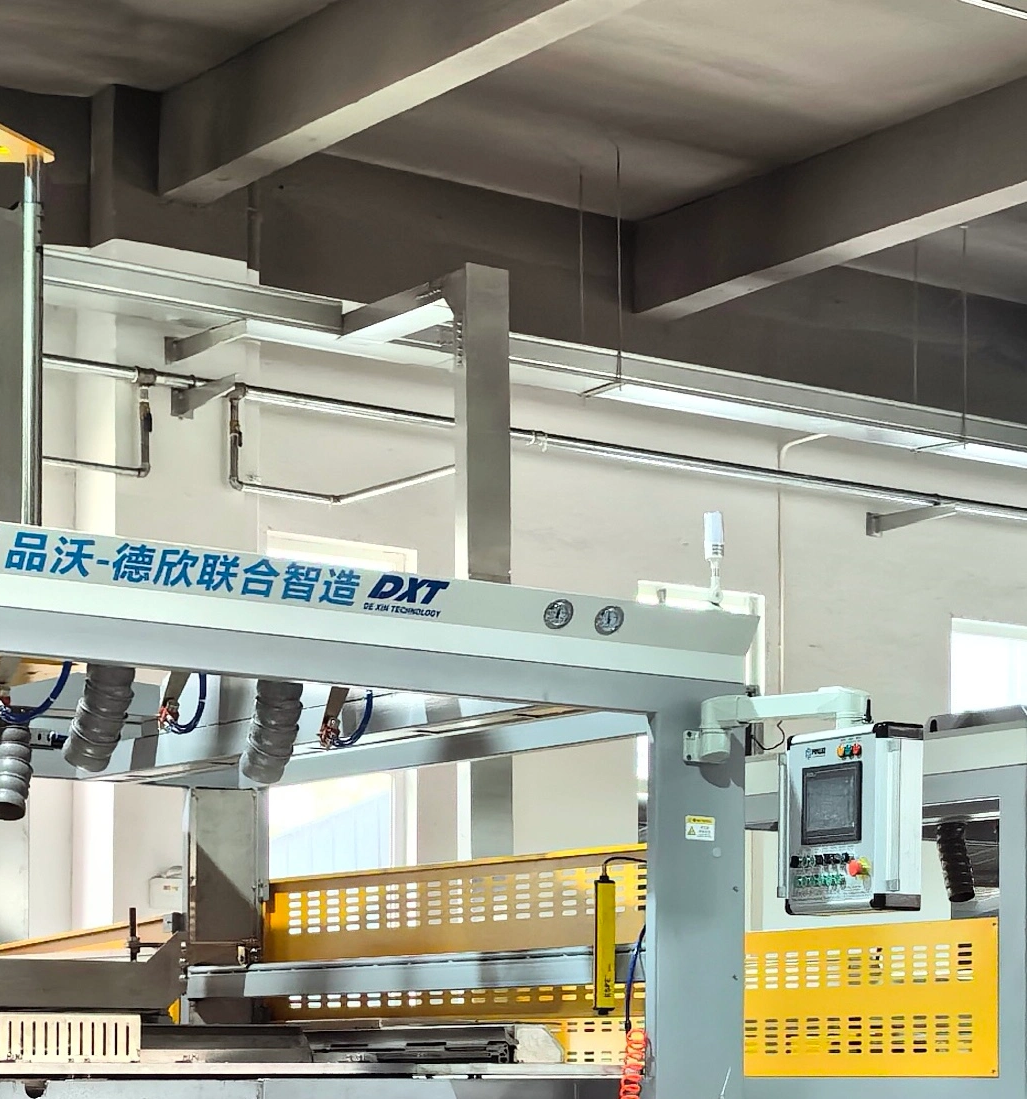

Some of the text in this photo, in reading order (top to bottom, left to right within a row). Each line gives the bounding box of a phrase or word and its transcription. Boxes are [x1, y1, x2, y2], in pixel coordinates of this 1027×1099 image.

[5, 531, 361, 607] 品沃-德欣联合智造
[367, 574, 450, 605] DXT
[363, 602, 441, 618] DE XIN TECHNOLOGY
